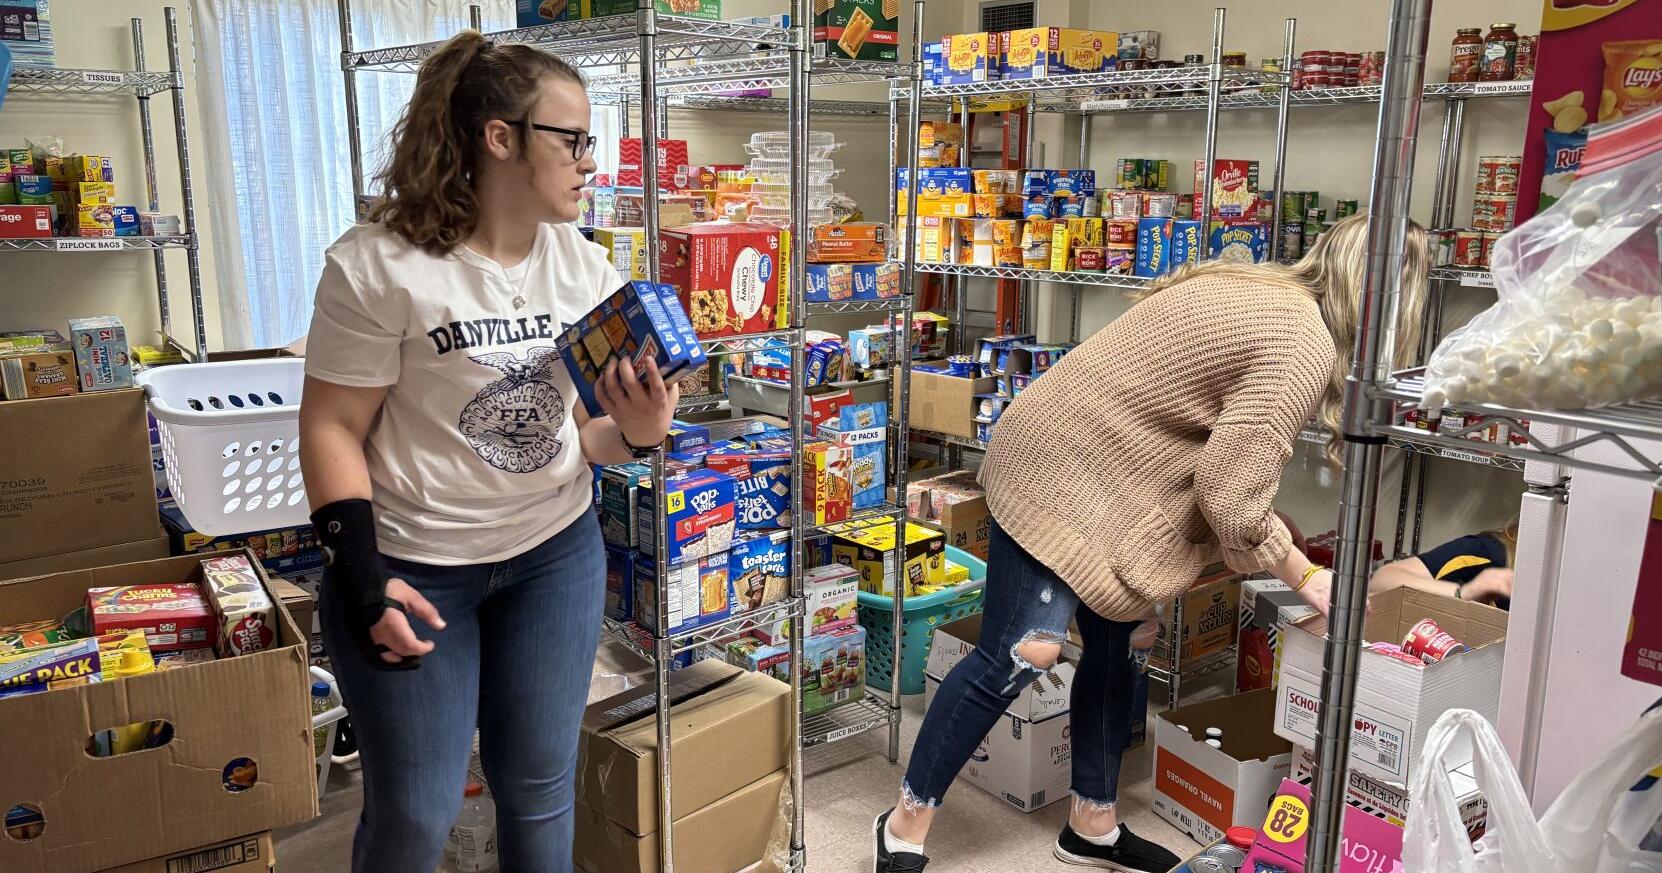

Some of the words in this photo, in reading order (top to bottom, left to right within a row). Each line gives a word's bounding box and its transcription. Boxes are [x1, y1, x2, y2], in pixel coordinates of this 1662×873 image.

[988, 34, 997, 43] 12
[1002, 33, 1010, 42] 12
[1050, 30, 1059, 39] 12
[943, 38, 951, 47] 12
[1455, 45, 1480, 54] Prego
[86, 74, 121, 83] TISSUES
[1476, 85, 1507, 93] TOMATO
[1555, 148, 1586, 169] RUF
[1221, 168, 1241, 181] Orville
[0, 214, 22, 222] rage
[113, 207, 128, 215] loc
[103, 229, 113, 237] 50
[769, 235, 778, 250] 48
[779, 251, 787, 286] FAMILY
[740, 266, 749, 302] Chewy
[100, 329, 111, 341] 12
[427, 314, 552, 354] DANVILLE
[480, 395, 555, 422] AGRICULTURAL
[499, 407, 541, 422] FFA
[858, 432, 879, 441] PACKS
[485, 435, 549, 459] EDUCATION
[803, 451, 816, 463] ACK
[852, 456, 873, 468] Teddy
[1442, 450, 1471, 460] TOMATO
[1471, 455, 1490, 464] SOUP
[738, 476, 769, 495] BITE
[816, 468, 825, 502] PACK
[0, 501, 32, 513] RUNCH
[671, 497, 681, 507] 16
[817, 504, 825, 512] 9
[955, 531, 968, 541] 24
[296, 553, 321, 565] clas
[741, 548, 787, 569] toaster
[762, 563, 785, 574] tarts
[822, 586, 855, 599] ORGANIC
[1207, 601, 1228, 621] CUP
[244, 618, 263, 651] Snac
[3, 673, 34, 688] UE
[36, 658, 93, 682] PACK
[1289, 692, 1319, 713] SCHOL
[829, 728, 847, 740] JUICE
[847, 721, 867, 734] BOXES
[1378, 729, 1399, 743] LETTER
[1050, 743, 1071, 757] PERO
[1166, 769, 1199, 796] ORANGES
[1350, 774, 1403, 808] SAFETY
[1200, 790, 1222, 812] NAVEL
[1281, 800, 1304, 815] BAGS
[1180, 814, 1192, 829] ITEM
[1269, 808, 1302, 838] 28
[1341, 837, 1387, 873] flav
